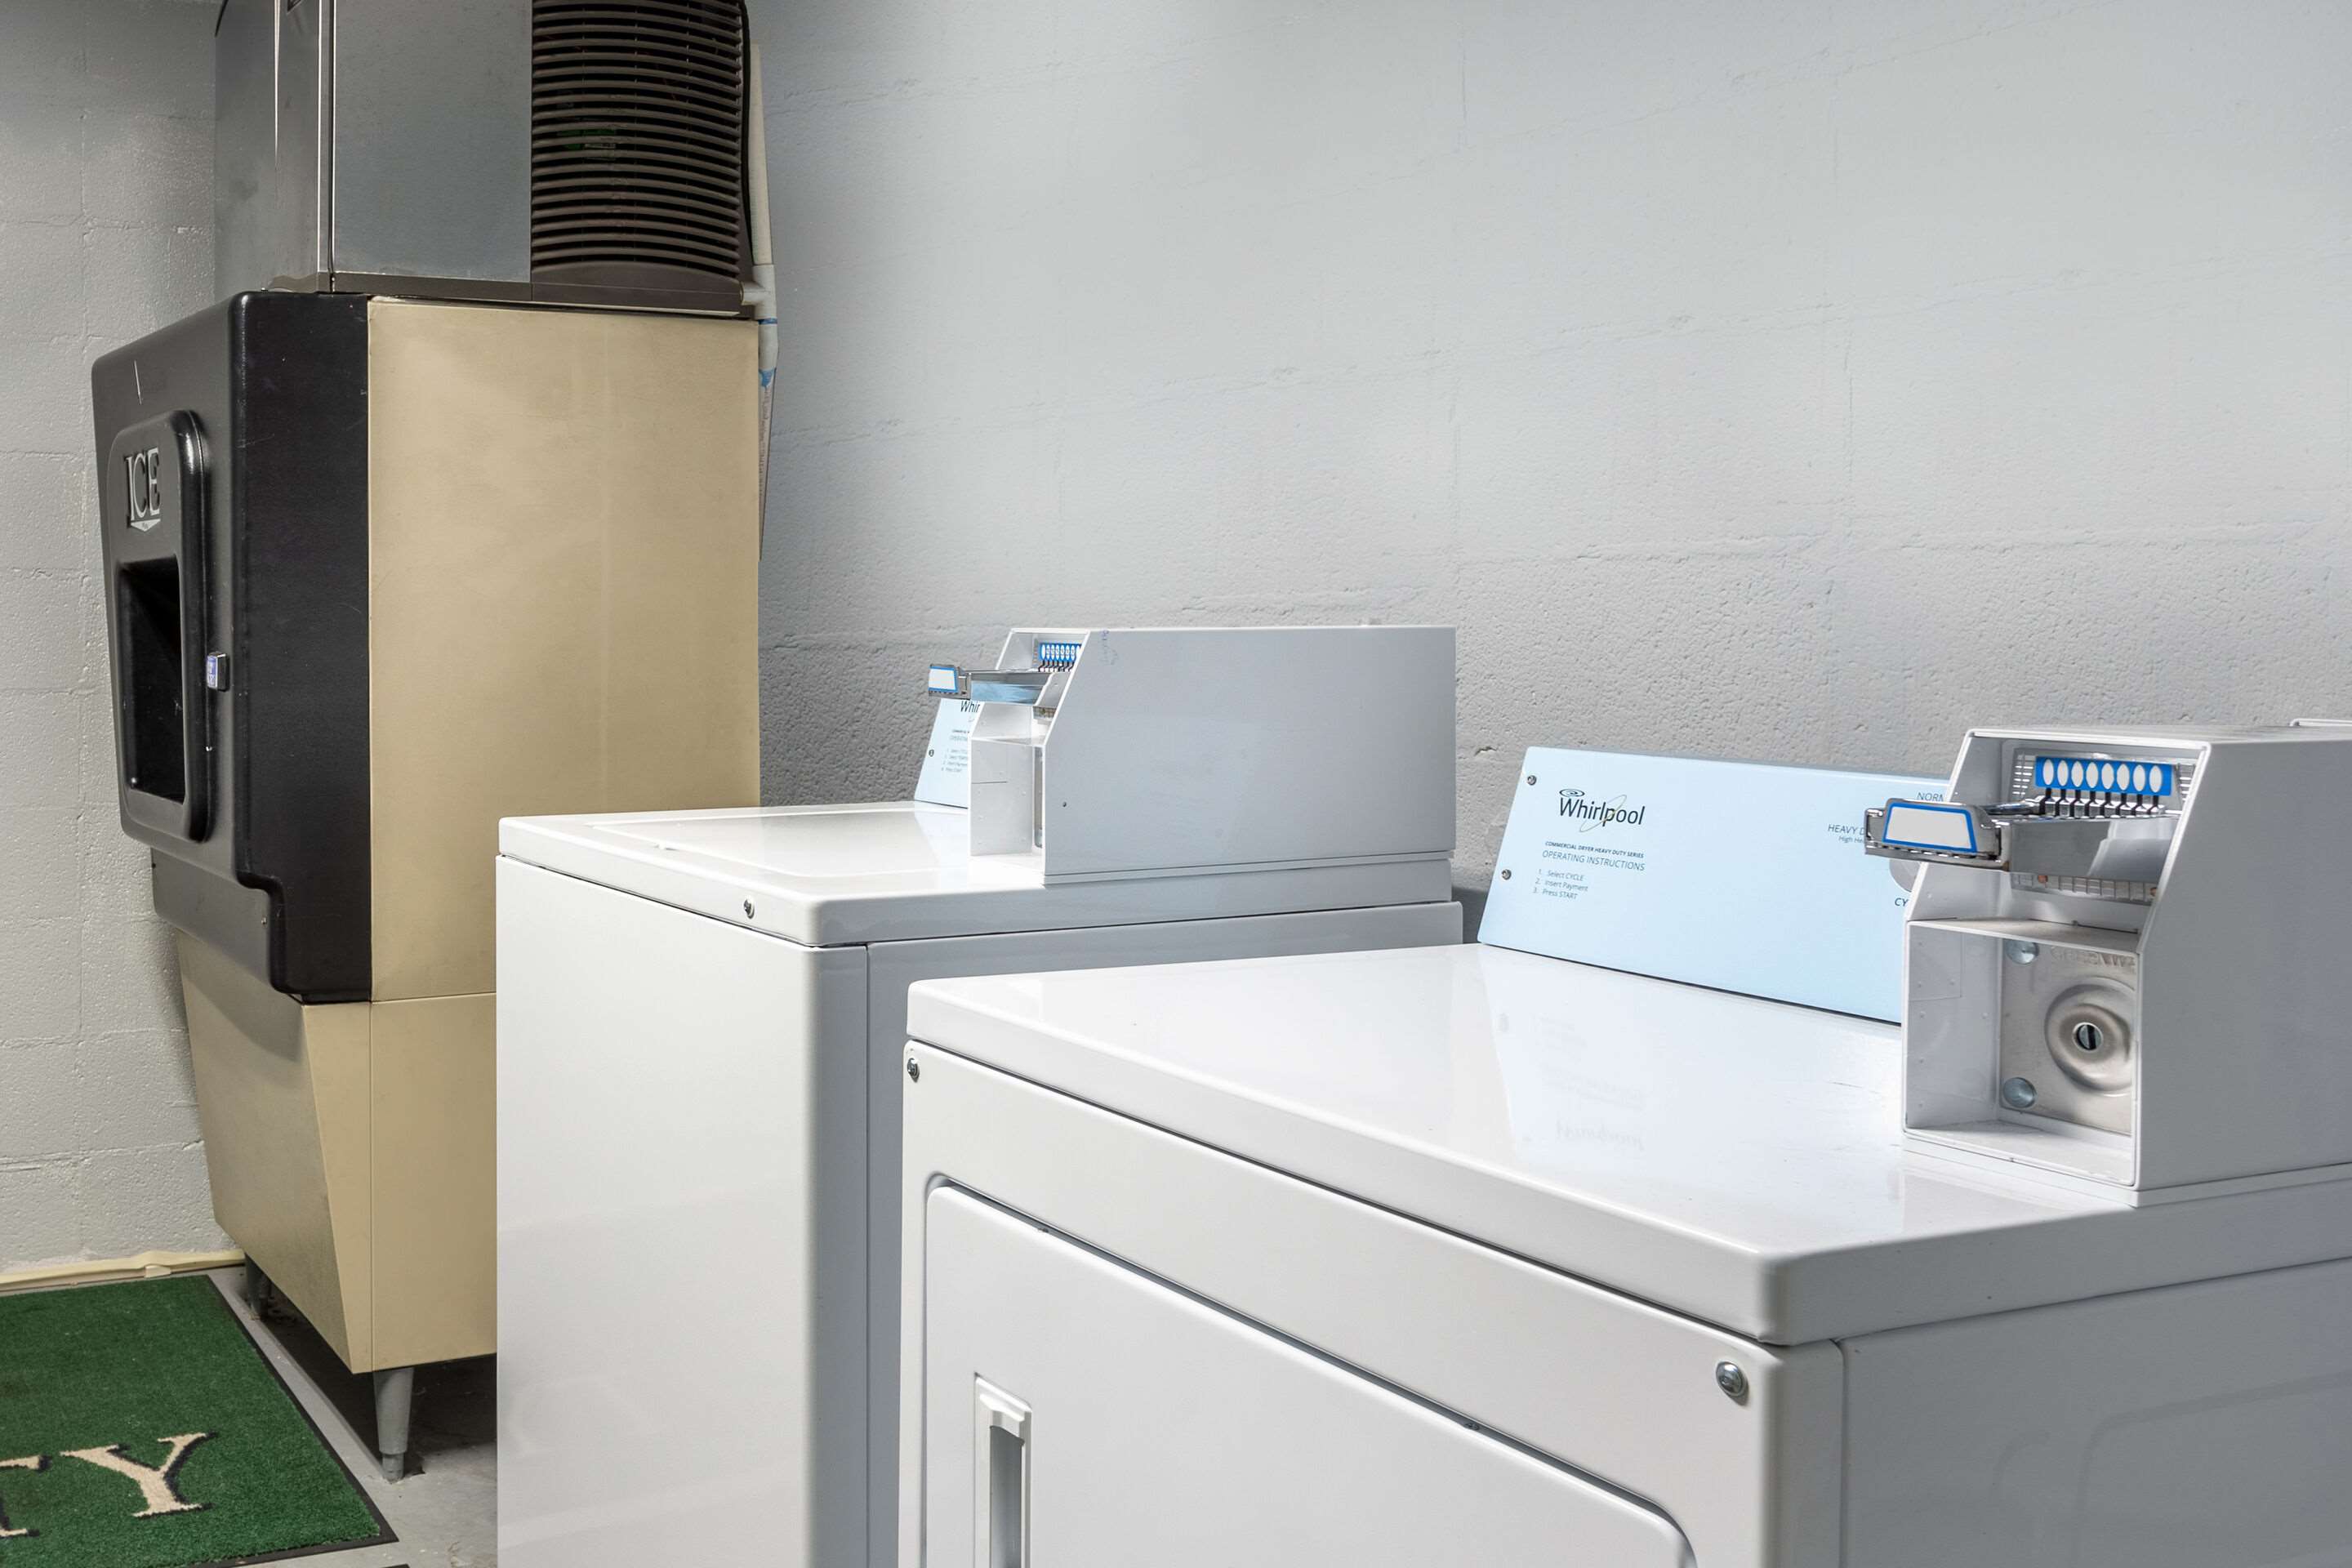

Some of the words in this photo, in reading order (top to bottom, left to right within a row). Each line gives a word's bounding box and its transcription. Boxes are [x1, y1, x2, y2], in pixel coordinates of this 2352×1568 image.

[126, 448, 160, 521] ICE
[1560, 797, 1646, 827] Whirlpool
[1828, 824, 1858, 835] HEAVY
[1838, 835, 1852, 844] High
[1545, 840, 1577, 850] COMMERCIAL
[1612, 849, 1627, 857] DUTY
[1628, 851, 1644, 859] SERIES
[1542, 849, 1585, 863] OPERATING
[1587, 855, 1646, 871] INSTRUCTIONS
[1548, 870, 1565, 880] Select
[1566, 872, 1584, 882] CYCLE
[1562, 882, 1588, 892] Payment
[1542, 888, 1558, 897] Press
[1559, 891, 1578, 900] START
[1894, 898, 1909, 907] CY
